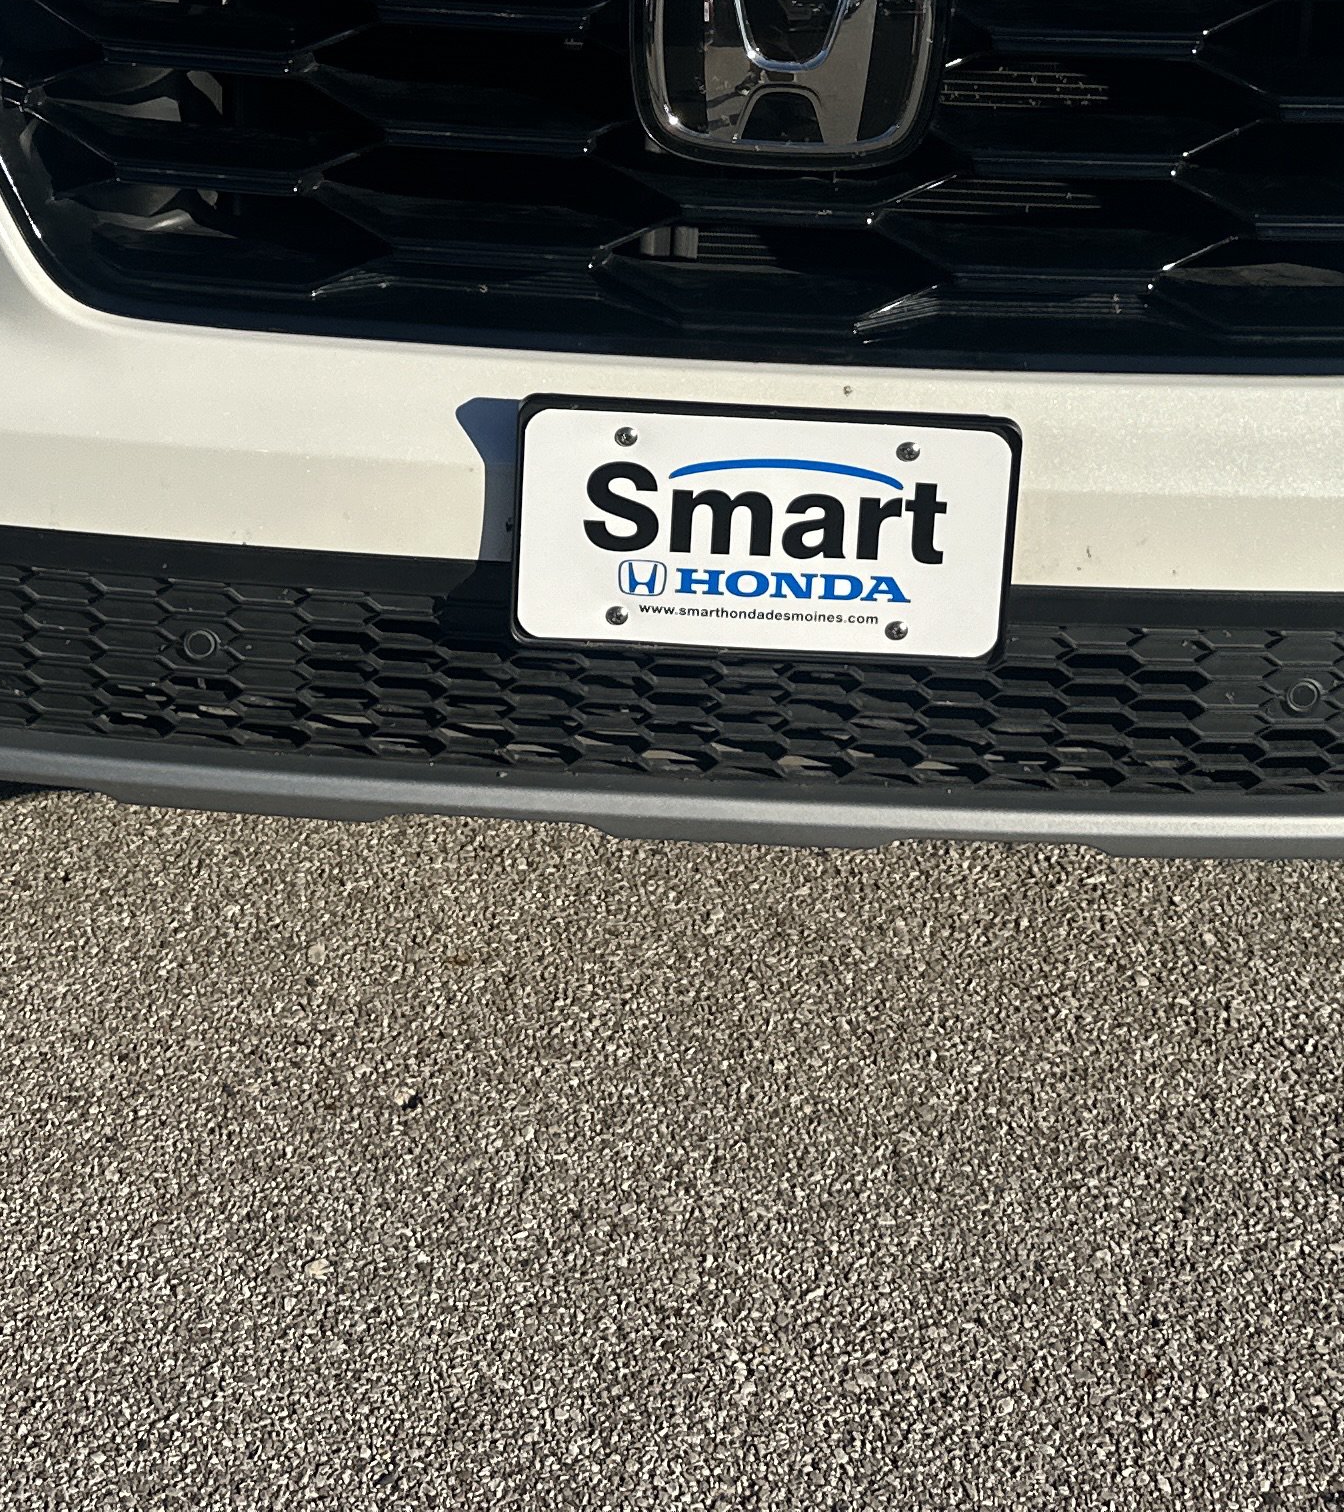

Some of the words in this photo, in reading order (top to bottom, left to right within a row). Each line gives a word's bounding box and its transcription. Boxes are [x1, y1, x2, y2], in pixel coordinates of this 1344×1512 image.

[583, 460, 948, 566] Smart
[675, 567, 911, 604] HONDA
[639, 602, 880, 626] www.smarthondadesmoines.com
